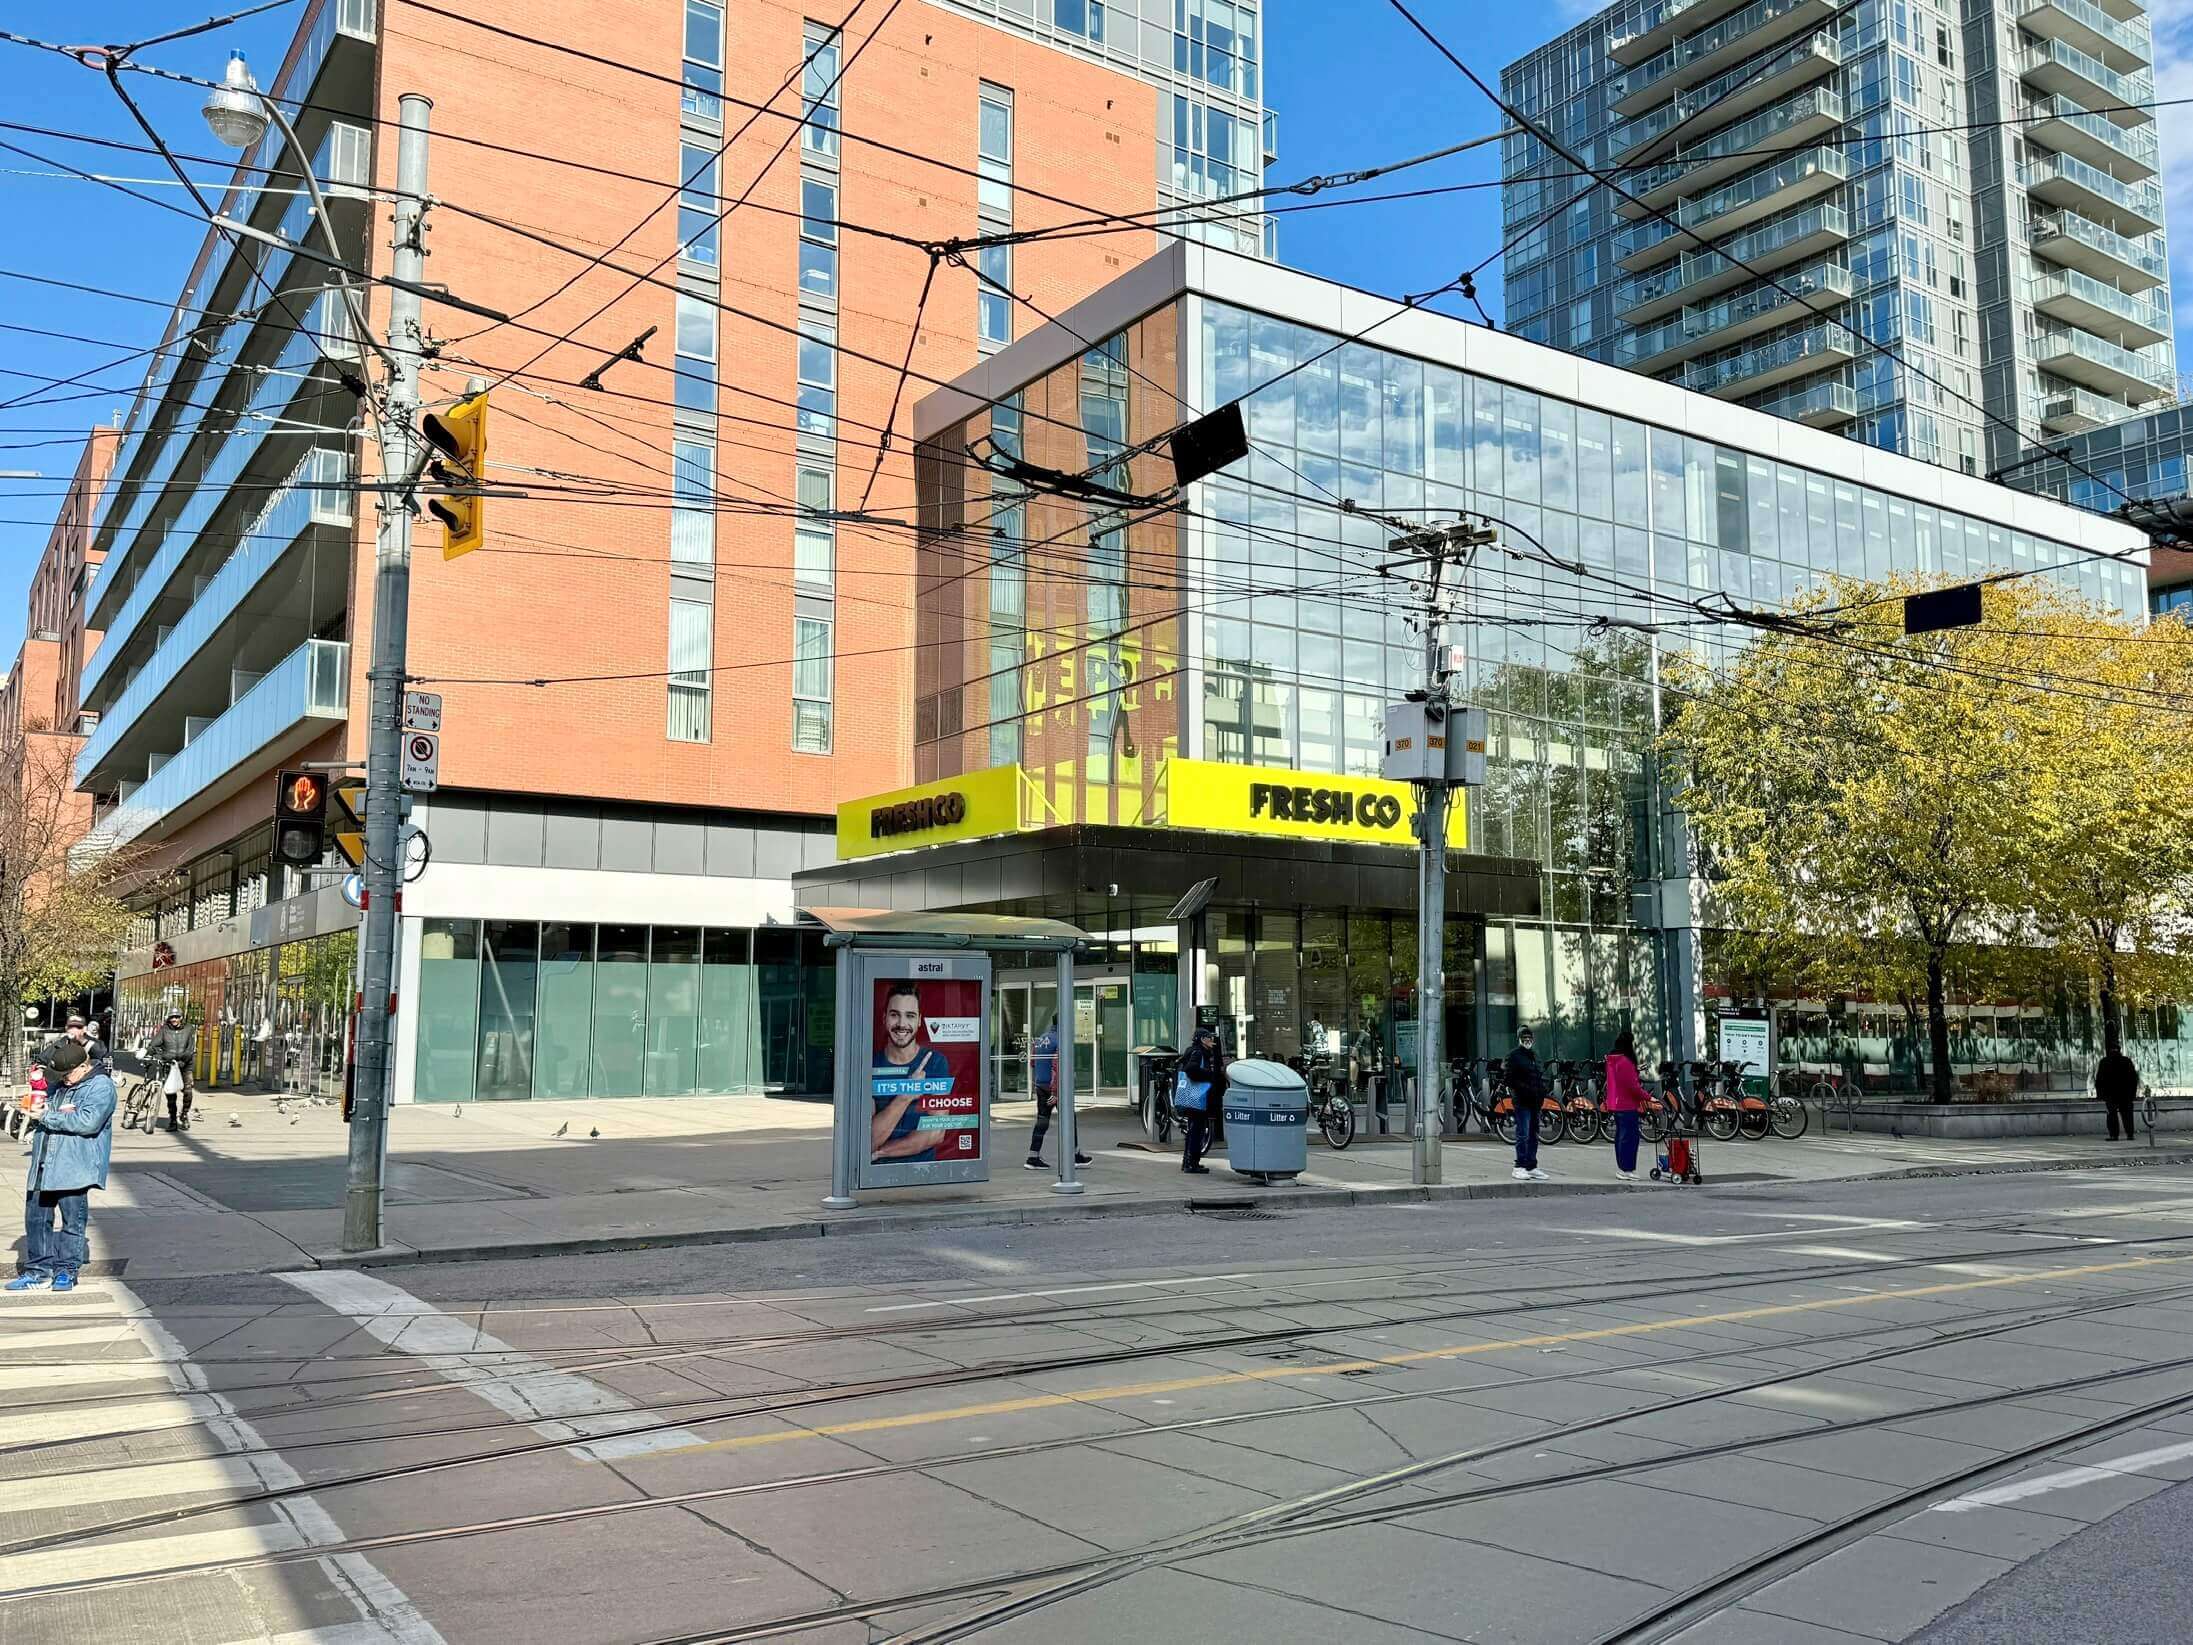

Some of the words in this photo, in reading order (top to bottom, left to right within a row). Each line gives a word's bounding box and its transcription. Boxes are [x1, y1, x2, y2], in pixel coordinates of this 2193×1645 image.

[419, 695, 430, 705] NO
[407, 705, 440, 718] STANDING
[1397, 738, 1410, 748] 370
[1429, 738, 1442, 746] 370
[918, 963, 944, 973] astral
[877, 1083, 897, 1093] IT'S
[900, 1082, 921, 1092] THE
[923, 1081, 947, 1092] ONE
[922, 1098, 926, 1109] I
[928, 1097, 973, 1108] CHOOSE
[1234, 1111, 1250, 1120] Litter
[1270, 1112, 1288, 1122] Litter
